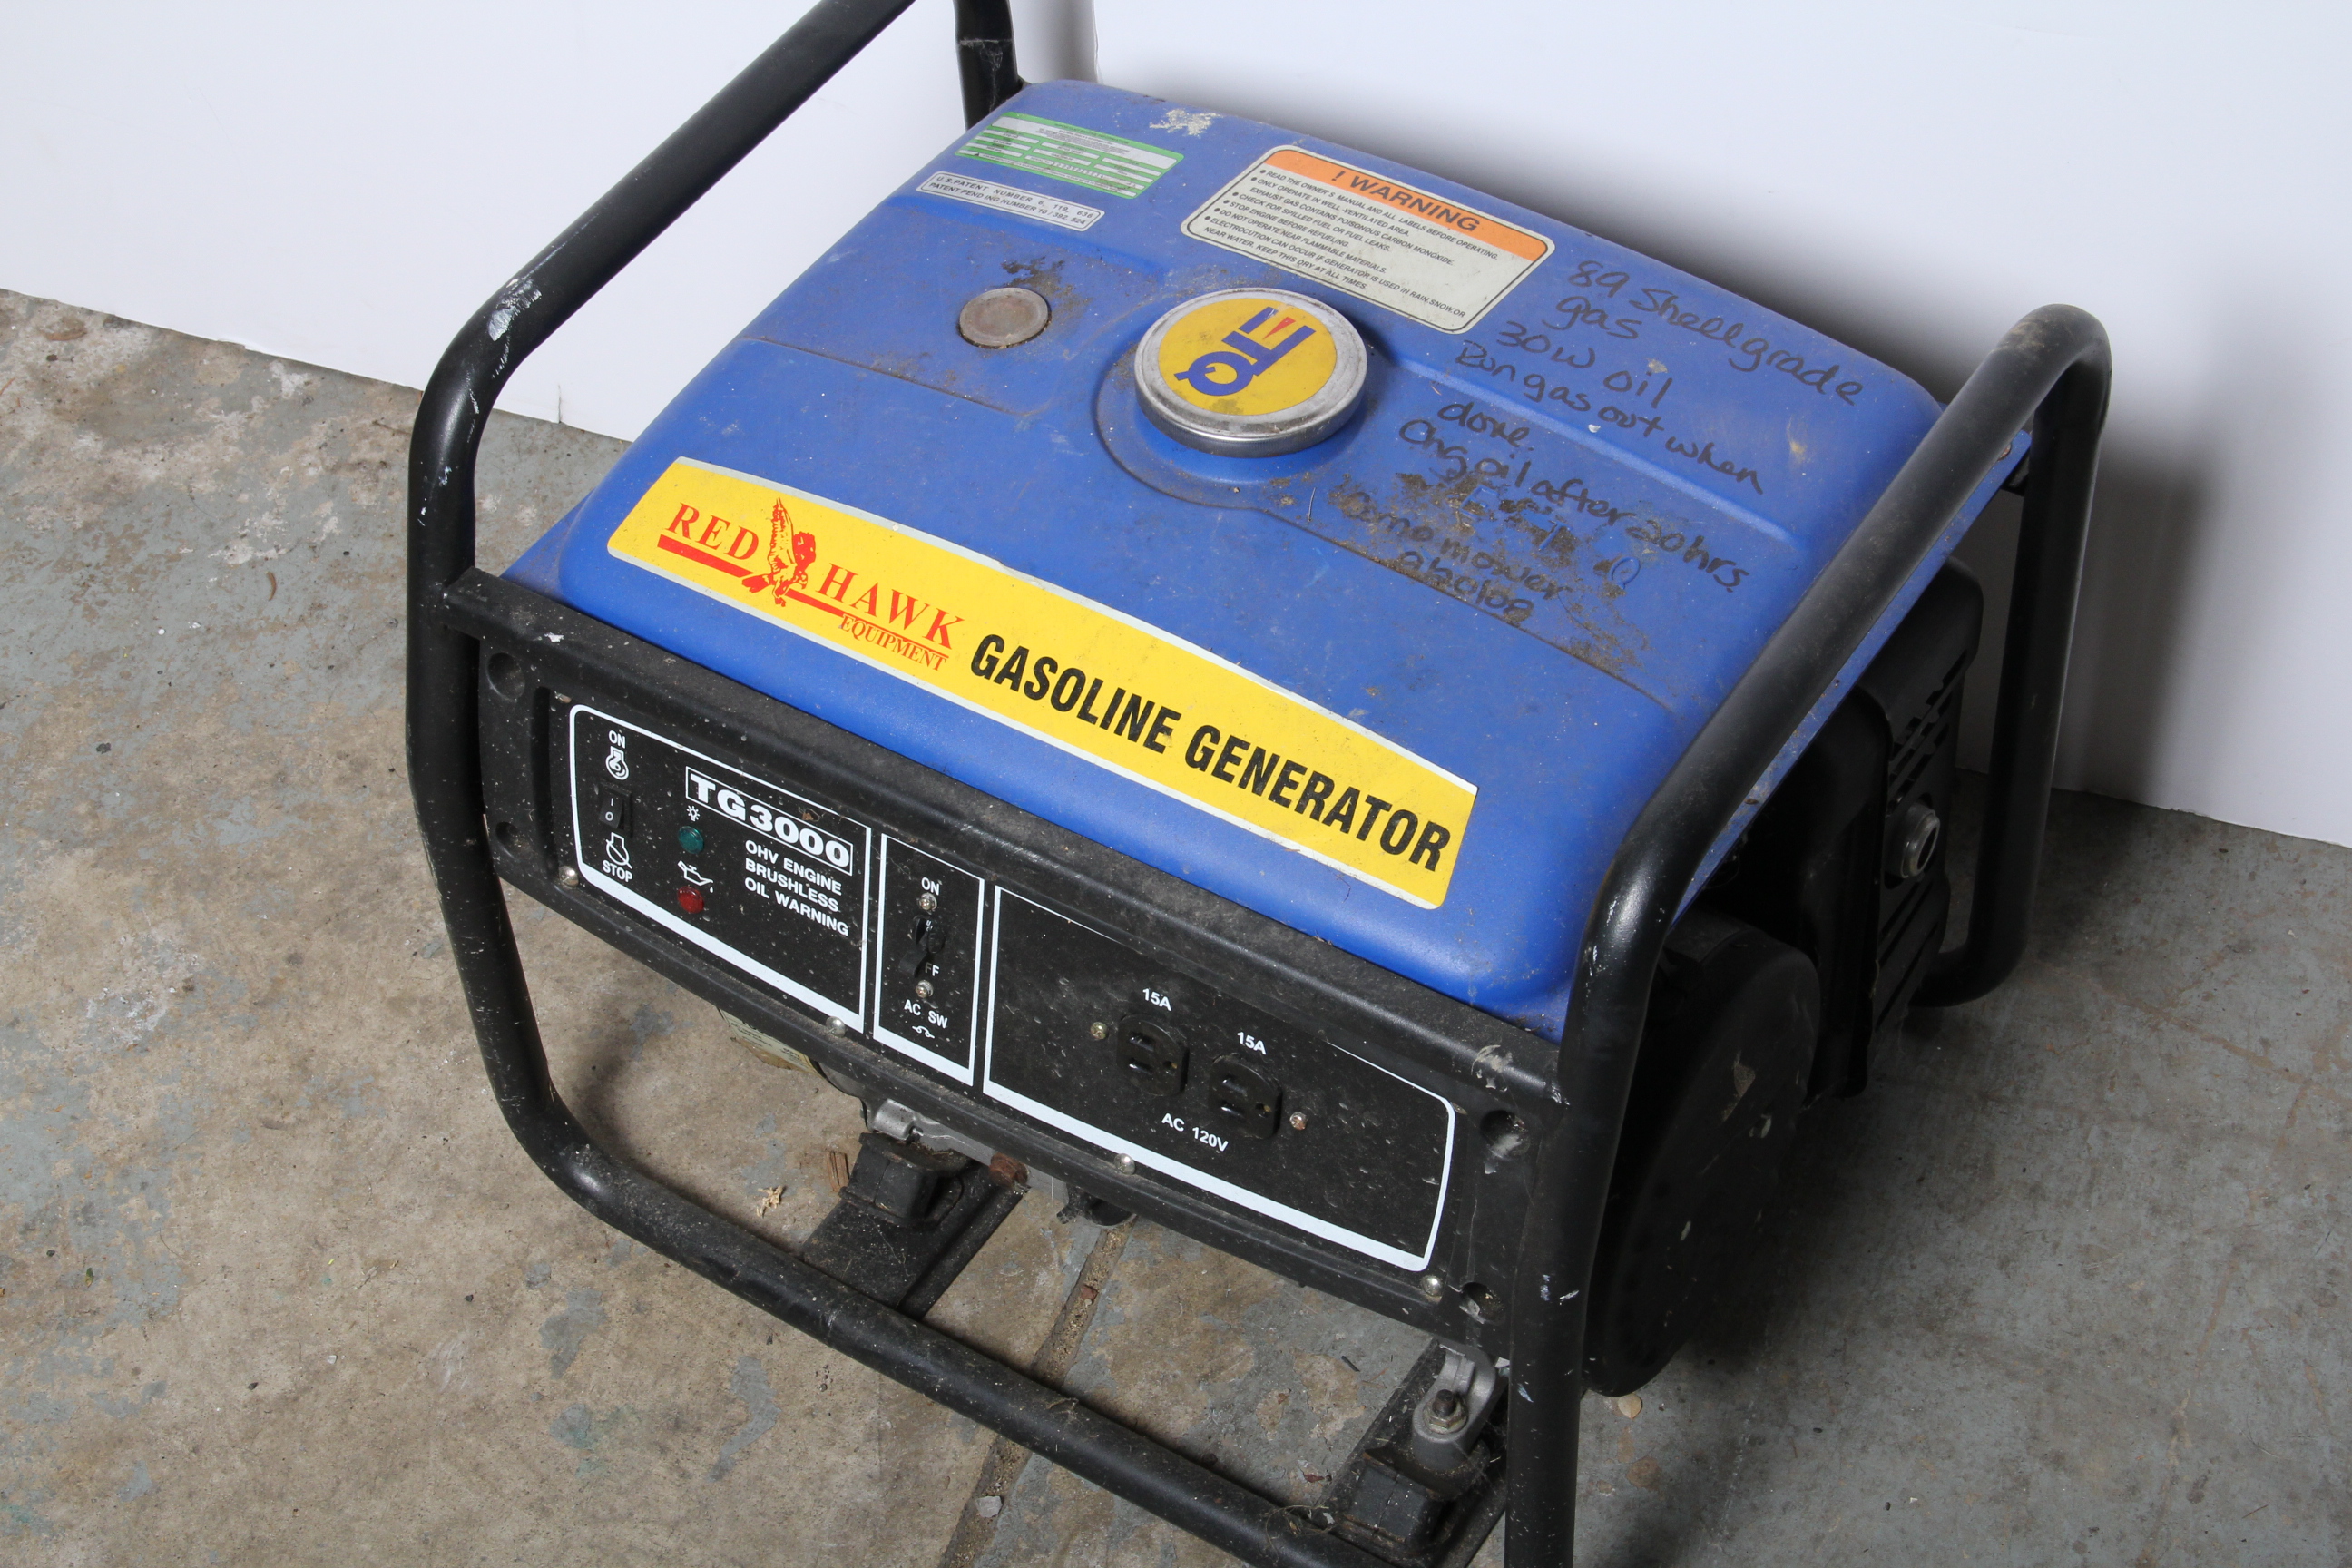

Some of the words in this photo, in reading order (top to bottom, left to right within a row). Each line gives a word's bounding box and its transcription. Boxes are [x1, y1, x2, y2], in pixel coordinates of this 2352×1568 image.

[928, 182, 961, 192] PATENT
[1000, 199, 1037, 211] NUMBER
[1070, 217, 1086, 225] 524
[993, 189, 1033, 202] NUMBER
[1076, 210, 1093, 218] 636
[1229, 201, 1250, 211] STOP
[1249, 208, 1279, 221] ENGINE
[1277, 218, 1308, 232] BEFORE
[1307, 229, 1349, 248] REFUELING.
[1239, 193, 1267, 206] CHECK
[1264, 202, 1282, 211] FOR
[1281, 208, 1313, 222] SPILLED
[1312, 219, 1331, 230] FUEL
[1344, 230, 1363, 241] FUEL
[1364, 238, 1390, 251] LEAKS.
[1250, 187, 1284, 201] EXHAUST
[1283, 198, 1299, 207] GAS
[1298, 203, 1338, 220] CONTAINS
[1336, 217, 1381, 236] POISONOUS
[1380, 233, 1414, 249] CARBON
[1412, 245, 1454, 265] MONOXIDE.
[1257, 178, 1279, 188] ONLY
[1277, 185, 1312, 200] OPERATE
[1320, 200, 1340, 211] WELL
[1387, 224, 1409, 237] AREA.
[1265, 171, 1287, 181] READ
[1286, 177, 1302, 186] THE
[1336, 194, 1366, 209] MANUAL
[1365, 205, 1383, 214] AND
[1381, 211, 1396, 220] ALL
[1397, 217, 1427, 231] LABELS
[1426, 228, 1456, 242] BEFORE
[1455, 240, 1498, 260] OPERATING.
[1350, 176, 1479, 231] WARNING
[1203, 226, 1227, 238] NEAR
[1255, 244, 1279, 255] KEEP
[1278, 251, 1298, 262] THIS
[1296, 259, 1315, 269] DRY
[1325, 270, 1340, 279] ALL
[1342, 275, 1367, 289] TIMES.
[1210, 218, 1272, 241] ELECTROCUTION
[1270, 238, 1289, 248] CAN
[1288, 244, 1317, 258] OCCUR
[1324, 258, 1370, 279] GENERATOR
[1377, 279, 1400, 290] USED
[1230, 213, 1249, 221] NOT
[1247, 218, 1284, 234] OPERATE
[1279, 230, 1302, 241] NEAR
[1300, 237, 1346, 257] FLAMMABLE
[1345, 253, 1387, 273] MATERIALS.
[1568, 260, 1630, 298] 89
[1524, 373, 1591, 411] gas
[1665, 436, 1763, 495] when
[1531, 478, 1636, 526] after
[667, 502, 760, 561] RED
[815, 563, 965, 650] HAWK
[840, 614, 949, 671] EQUIPMENT
[608, 730, 626, 749] ON
[971, 634, 1181, 754] GASOLINE
[1184, 725, 1450, 872] GENERATOR
[690, 773, 850, 867] TG3000
[603, 860, 632, 883] STOP
[745, 838, 779, 865] OHV
[783, 858, 842, 896] ENGINE
[745, 858, 839, 913] BRUSHLESS
[921, 877, 940, 896] ON
[744, 877, 770, 901] OIL
[775, 892, 849, 937] WARNING
[904, 999, 921, 1016] AC
[928, 1010, 948, 1029] SW
[1142, 988, 1172, 1011] 15A
[1236, 1032, 1266, 1055] 15A
[1161, 1112, 1184, 1132] AC
[1192, 1127, 1228, 1152] 120V
